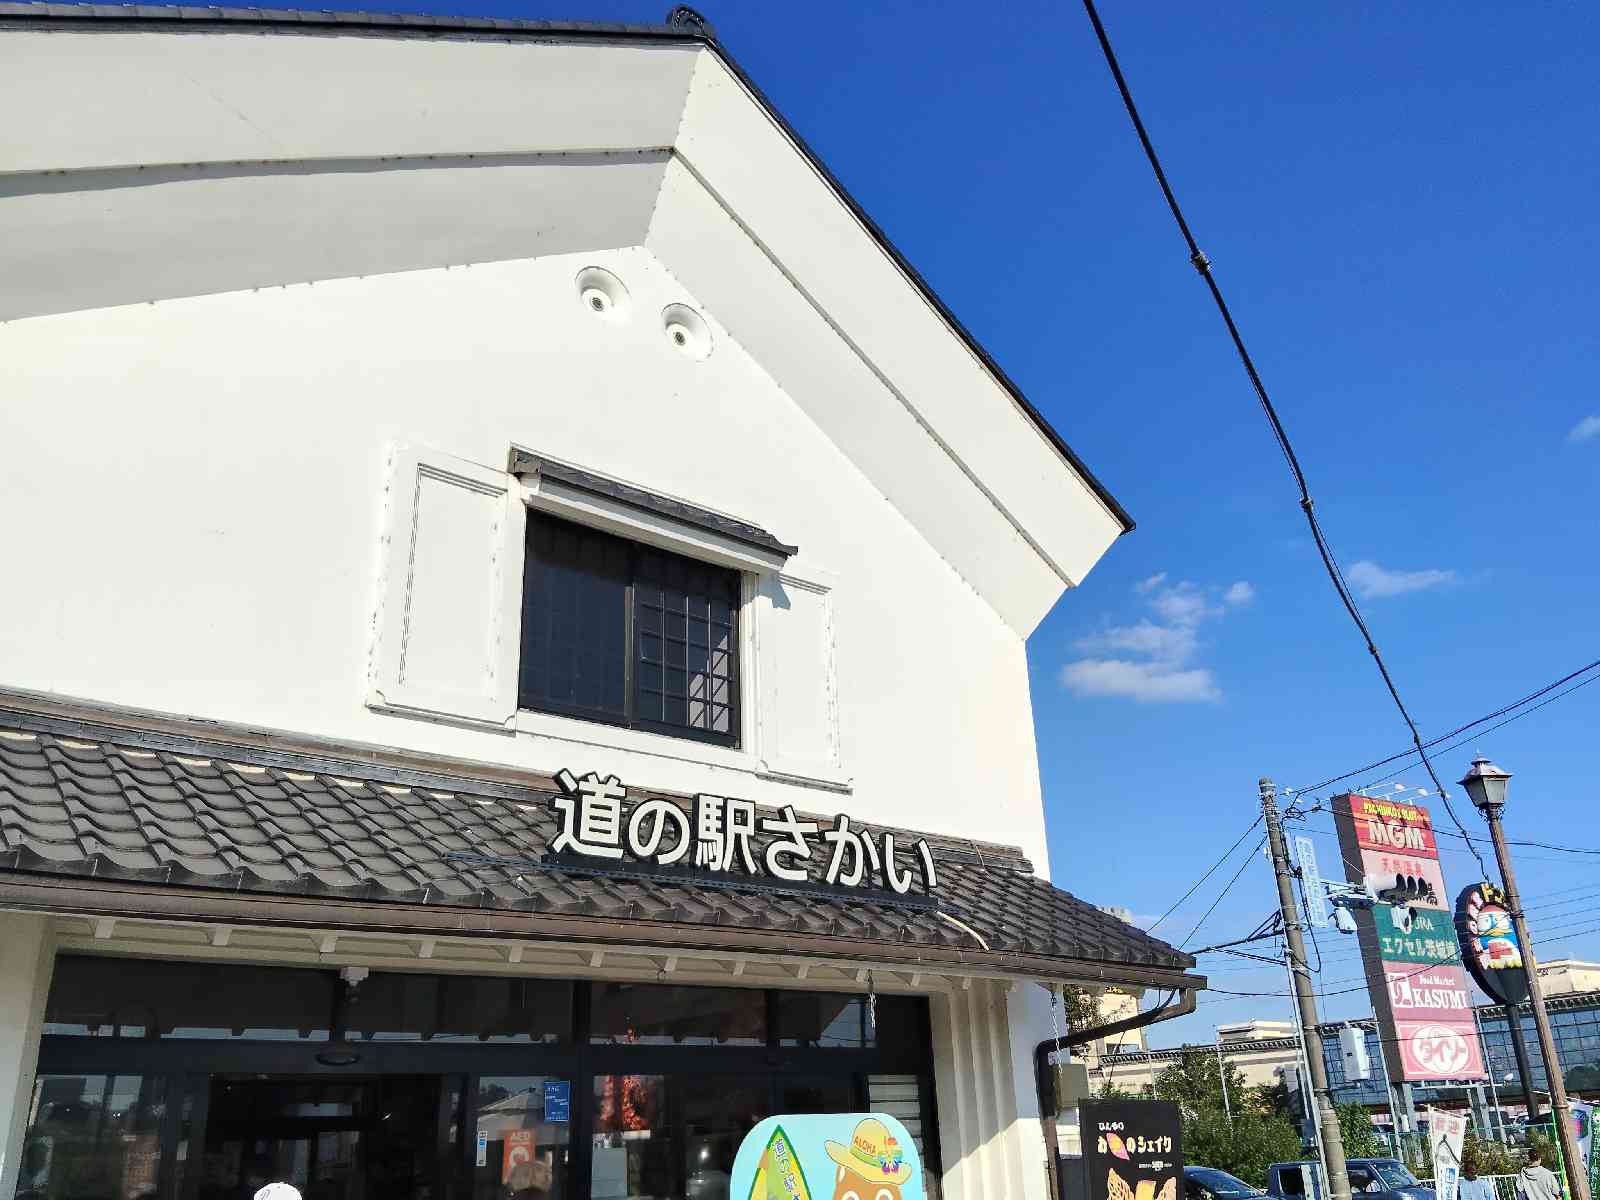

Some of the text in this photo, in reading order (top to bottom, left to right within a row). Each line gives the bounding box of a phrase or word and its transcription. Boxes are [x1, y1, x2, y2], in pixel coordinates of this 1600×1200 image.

[551, 768, 938, 895] 道の駅さかい
[1368, 818, 1425, 850] MGM
[1413, 989, 1469, 1010] KASUMI
